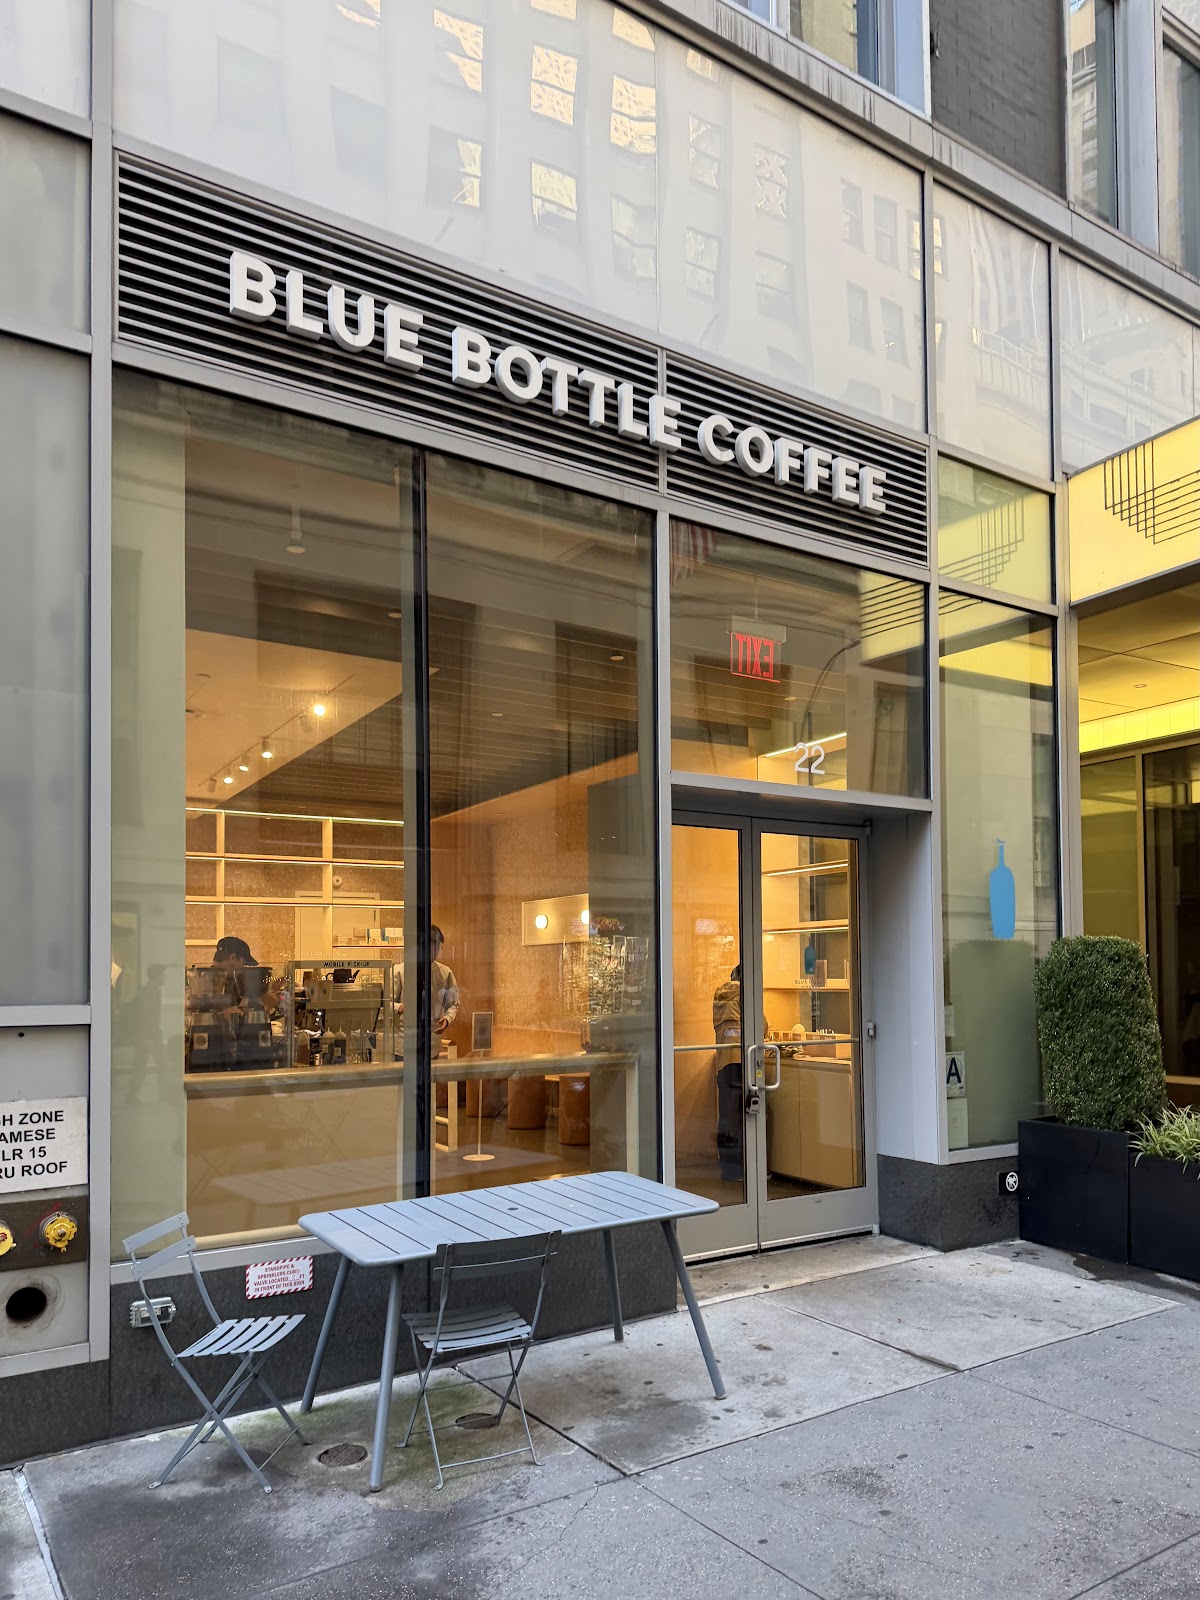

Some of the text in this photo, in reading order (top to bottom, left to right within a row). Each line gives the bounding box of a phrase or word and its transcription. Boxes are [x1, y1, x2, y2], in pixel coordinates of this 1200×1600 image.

[229, 250, 887, 515] BLUE BOTTLE COFFEE
[794, 742, 825, 774] 22
[946, 1056, 962, 1084] A
[0, 1110, 64, 1126] H ZONE
[29, 1146, 47, 1158] 15
[22, 1161, 68, 1177] ROOF
